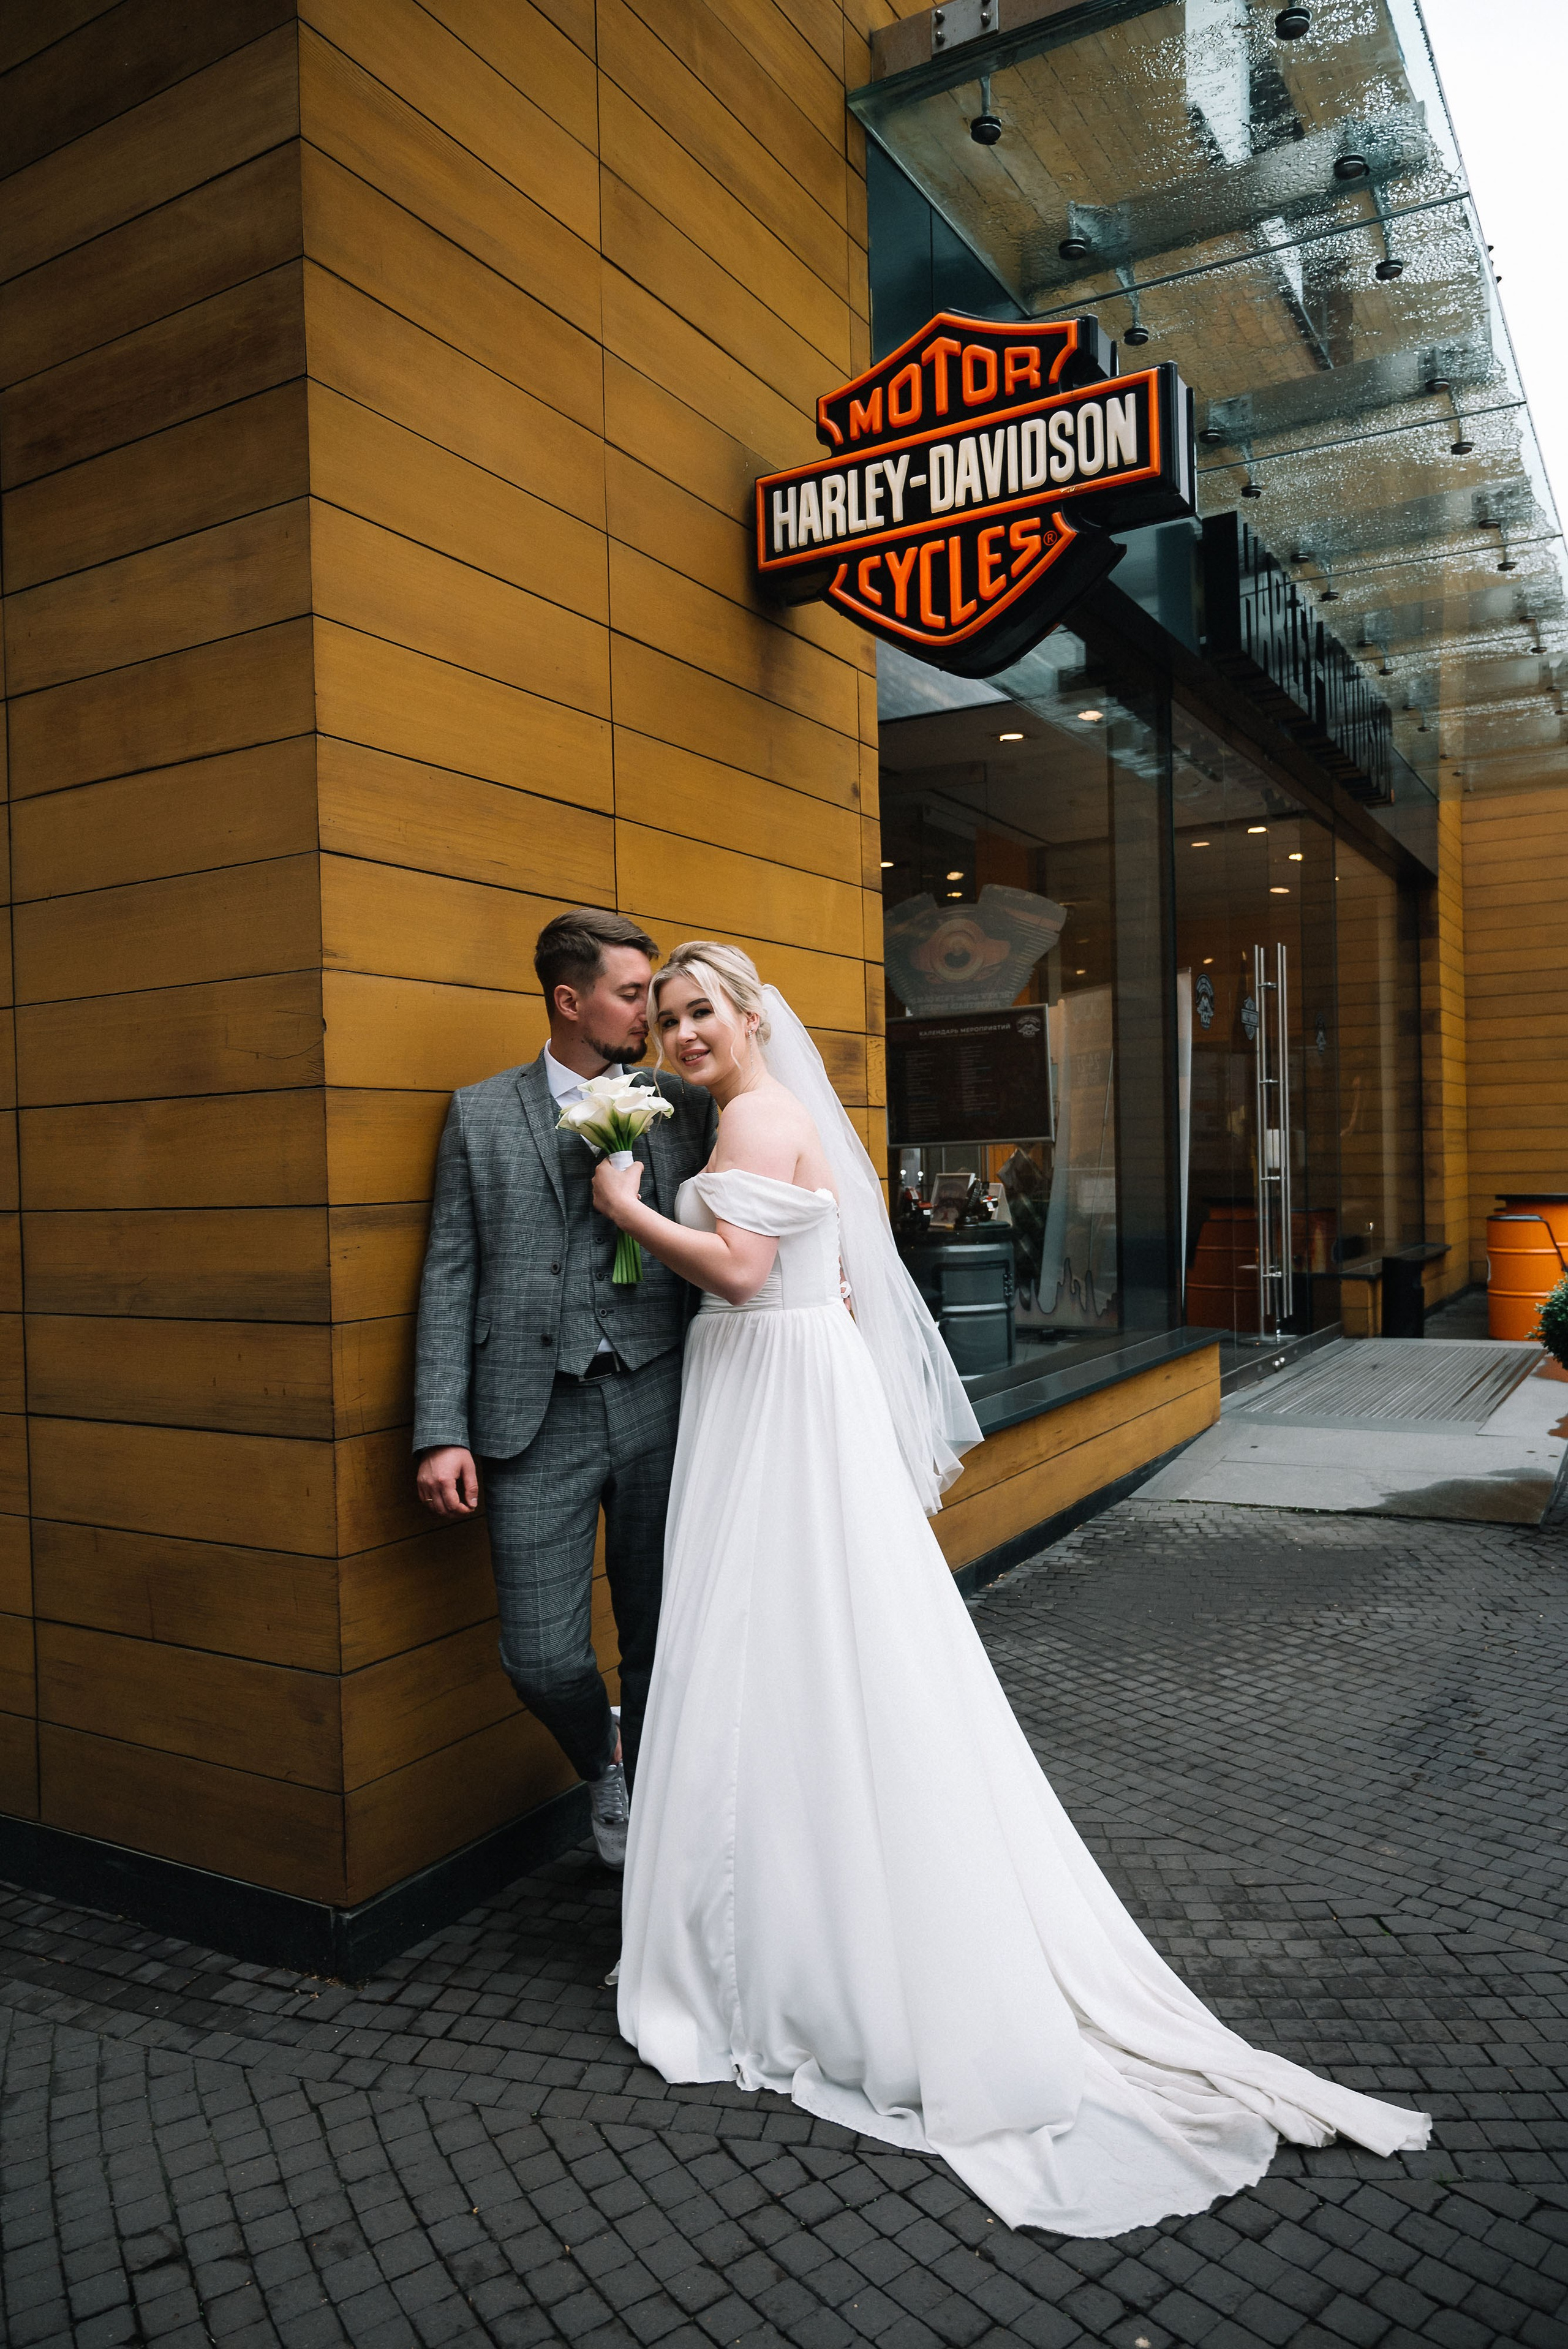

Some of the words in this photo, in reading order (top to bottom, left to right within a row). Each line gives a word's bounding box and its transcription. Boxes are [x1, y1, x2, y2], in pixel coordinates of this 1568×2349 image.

[850, 336, 1041, 441] MOTOR
[772, 393, 1138, 552] HARLEY-DAVIDSON
[858, 517, 1043, 630] CYCLES
[919, 1028, 959, 1036] КАЛЕНДАРЬ
[960, 1023, 1011, 1033] МЕРОПРИЯТИЙ
